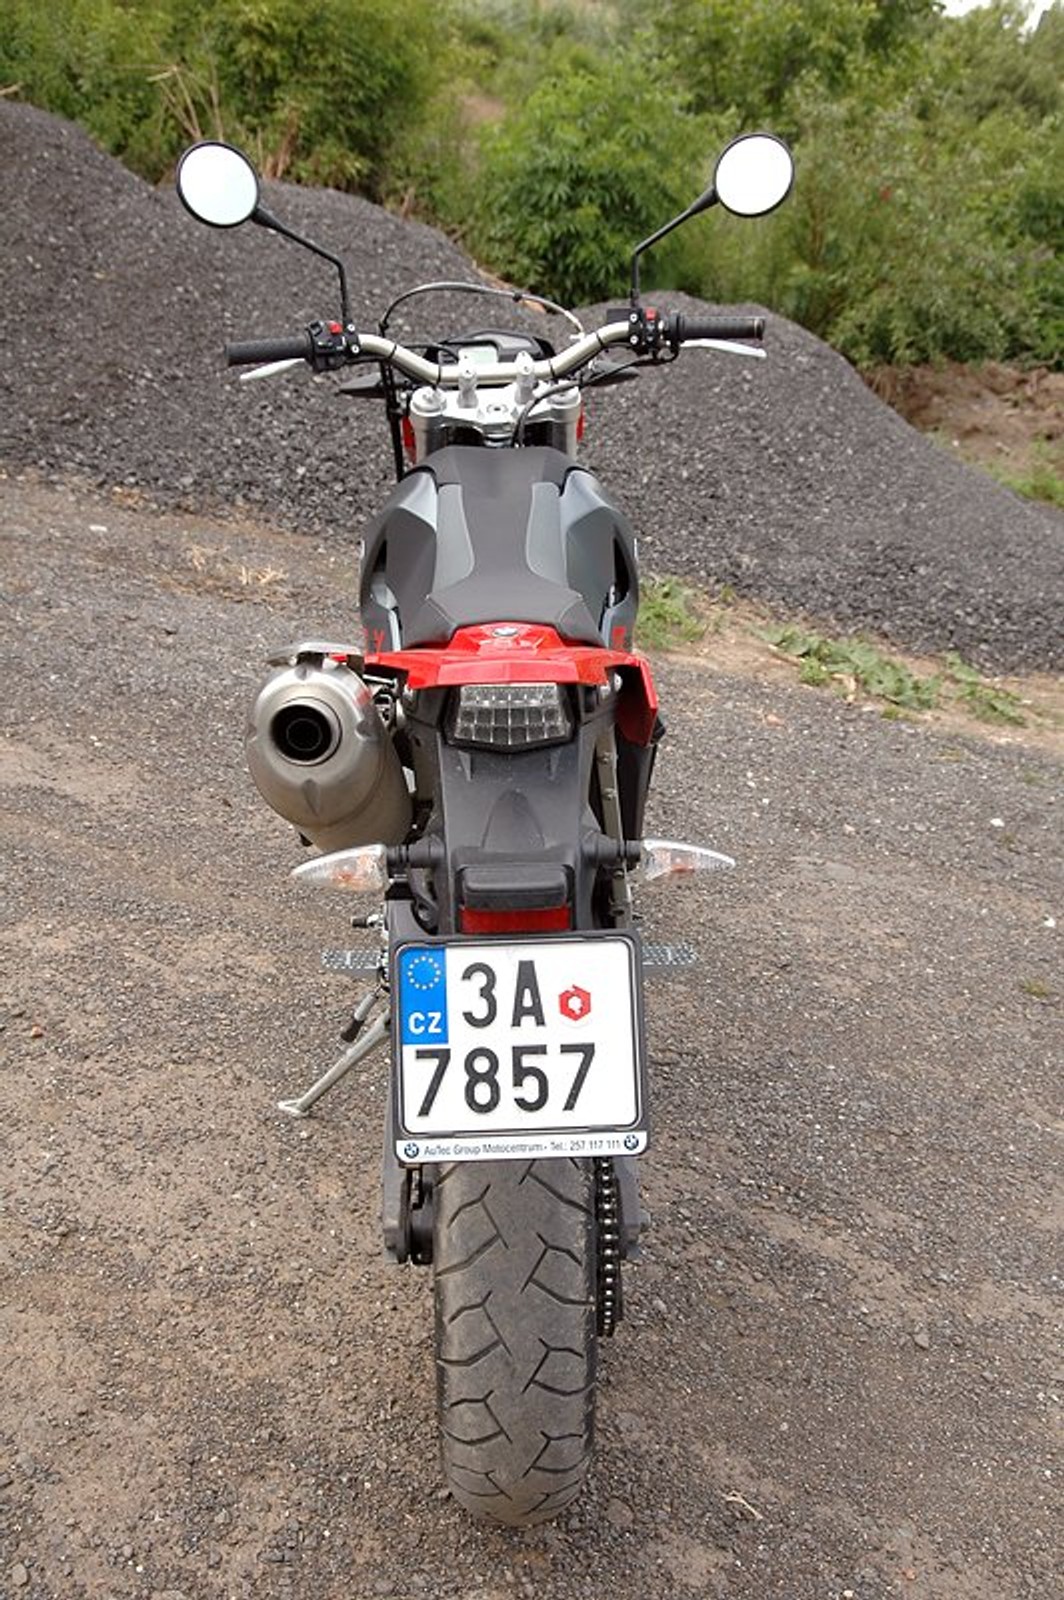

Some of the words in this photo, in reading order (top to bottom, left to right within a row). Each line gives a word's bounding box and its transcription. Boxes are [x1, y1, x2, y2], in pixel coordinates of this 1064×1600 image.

[461, 960, 546, 1028] 3A
[409, 1012, 441, 1034] CZ
[415, 1043, 595, 1117] 7857
[453, 1143, 481, 1156] Group
